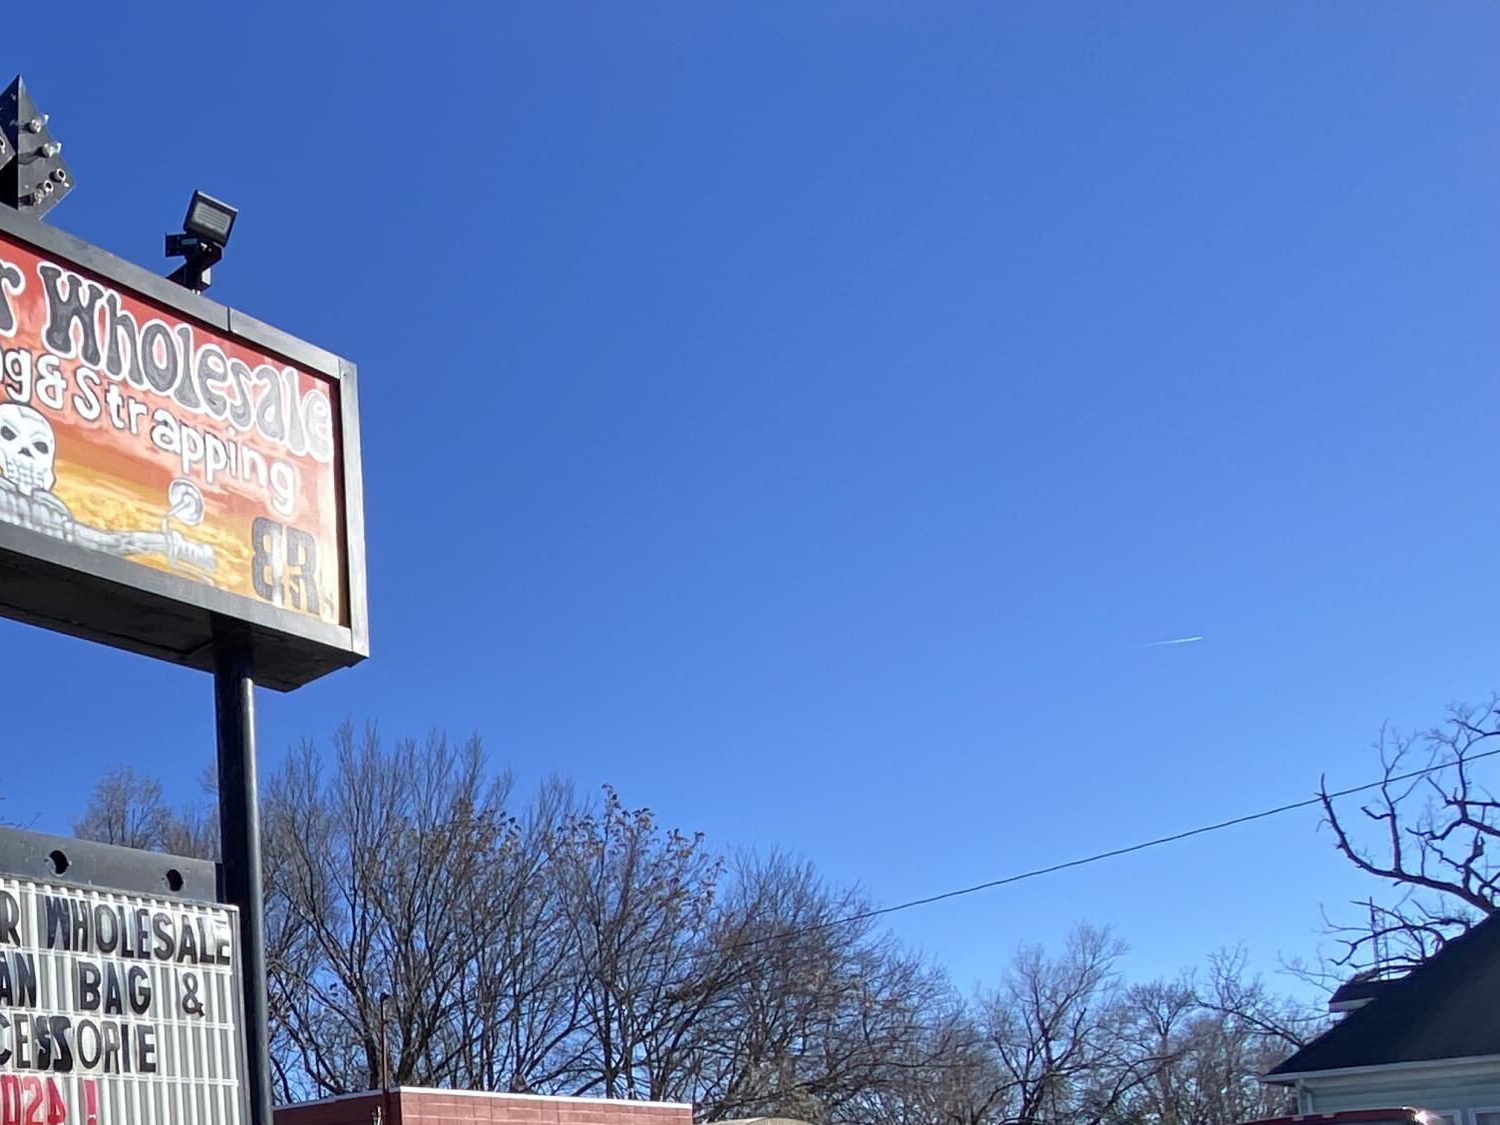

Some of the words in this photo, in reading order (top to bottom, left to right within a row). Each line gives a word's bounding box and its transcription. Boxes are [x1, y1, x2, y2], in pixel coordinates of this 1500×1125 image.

[36, 261, 334, 462] Wholesale
[44, 894, 232, 966] WHOLESALE
[78, 960, 152, 1016] BAG
[181, 971, 206, 1018] &
